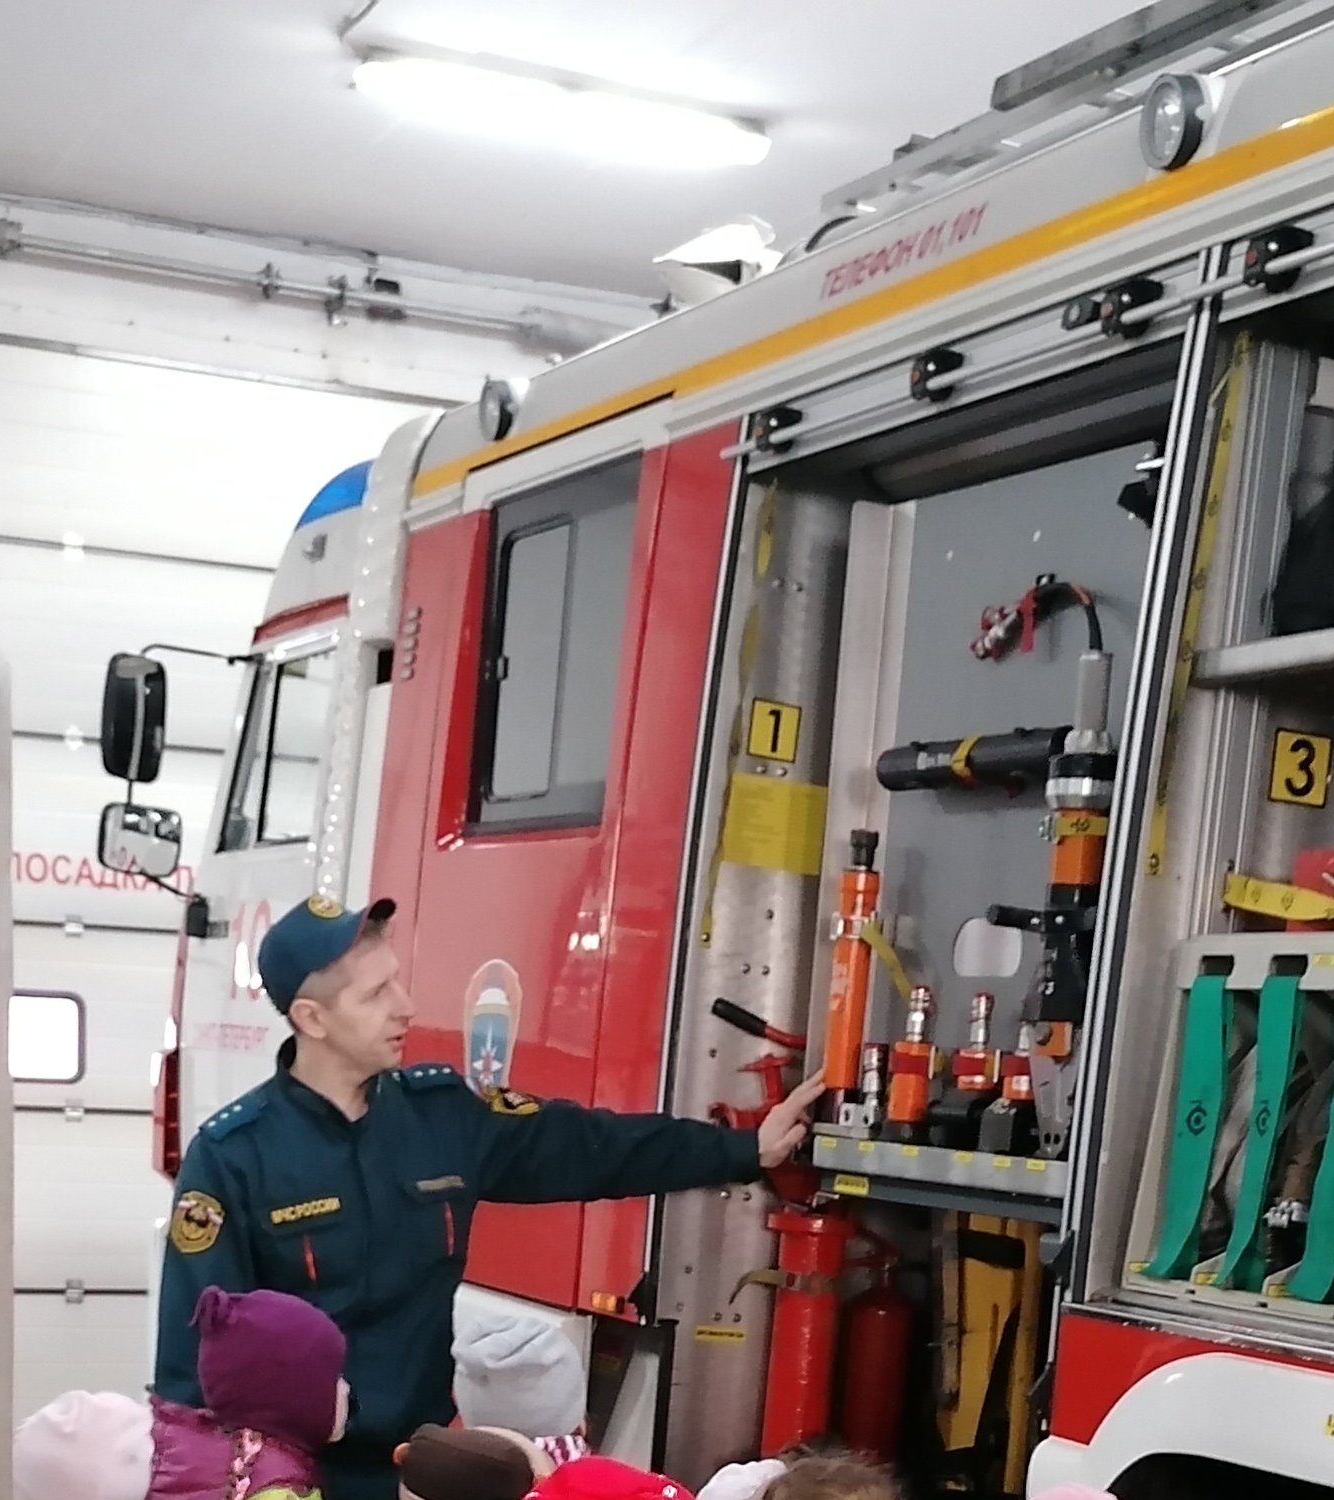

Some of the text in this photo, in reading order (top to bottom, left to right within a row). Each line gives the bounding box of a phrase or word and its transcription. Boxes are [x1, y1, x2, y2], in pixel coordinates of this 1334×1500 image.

[821, 234, 919, 298] ТЕЛЕФОН
[768, 709, 780, 753] 1
[1285, 739, 1315, 796] 3
